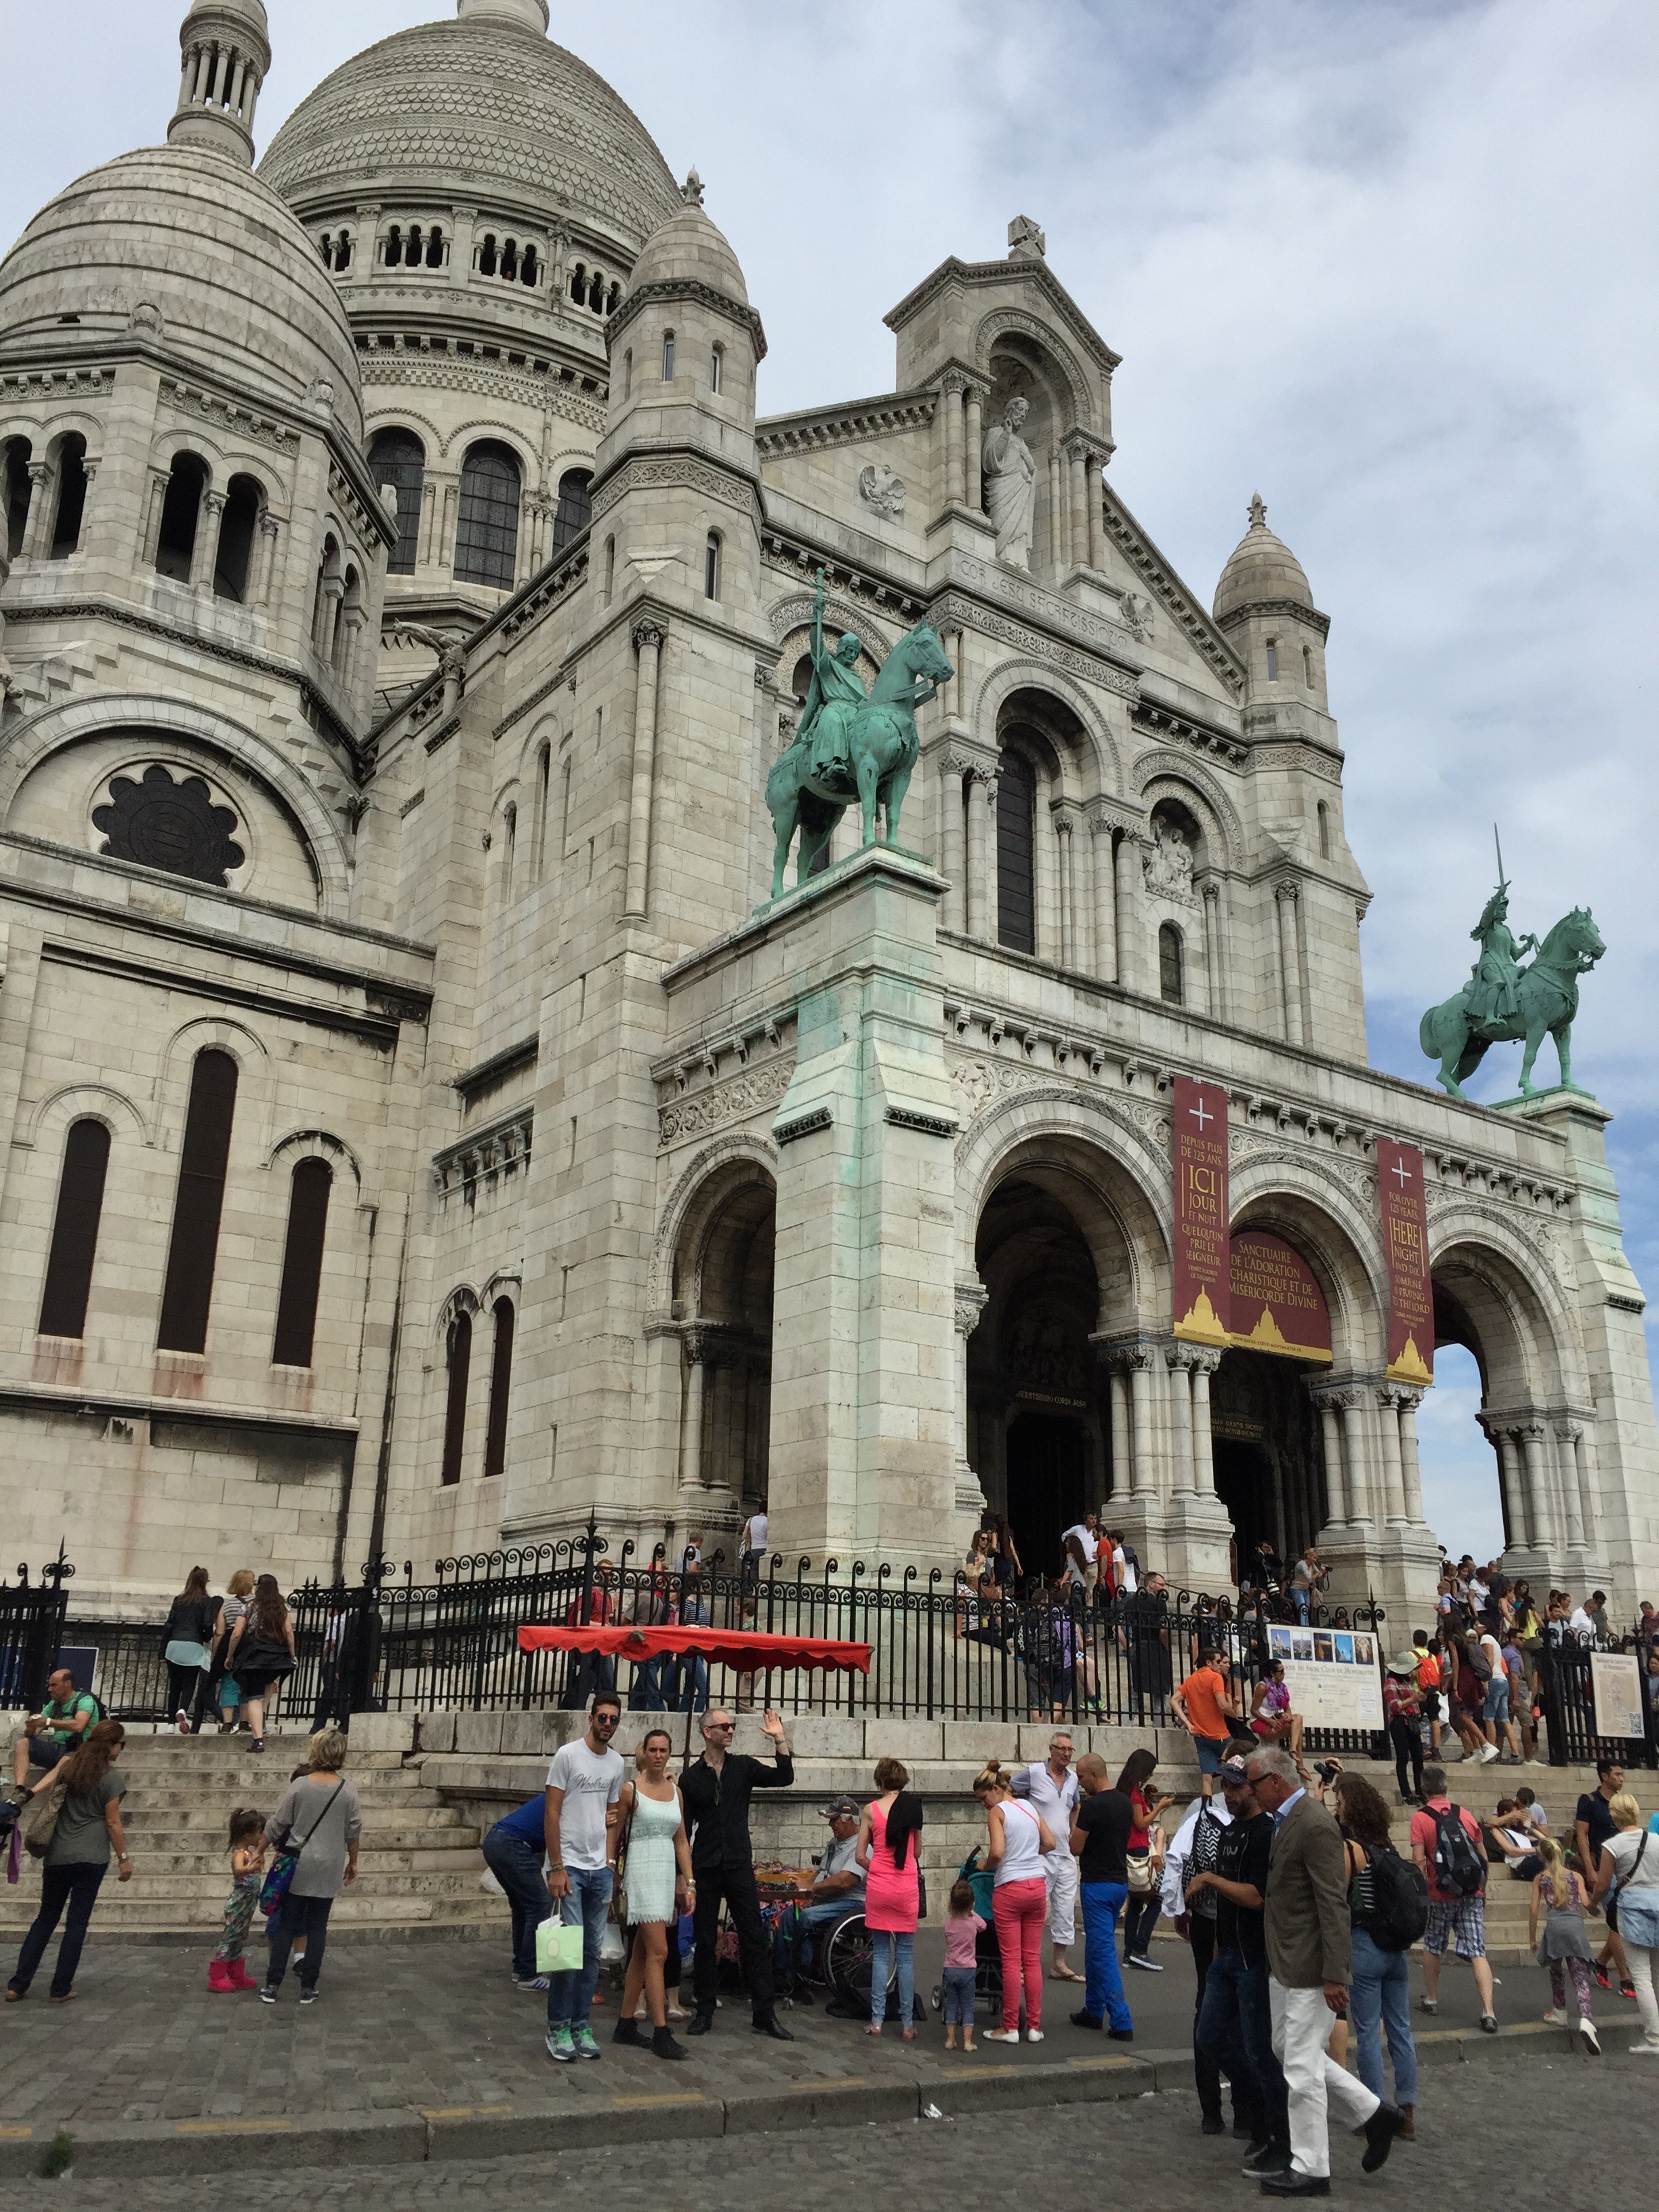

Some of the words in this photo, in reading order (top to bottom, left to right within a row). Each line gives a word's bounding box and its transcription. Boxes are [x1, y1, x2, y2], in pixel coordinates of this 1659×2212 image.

[960, 560, 987, 585] COR
[992, 575, 1025, 602] JESU
[1181, 1134, 1206, 1150] DEPUIS
[1207, 1141, 1223, 1155] PLUS
[1181, 1145, 1191, 1158] DE
[1193, 1149, 1205, 1162] 125
[1189, 1164, 1216, 1195] ICI
[1189, 1192, 1218, 1213] JOUR
[1389, 1191, 1401, 1204] FOR
[1401, 1195, 1418, 1210] OVER
[1389, 1202, 1400, 1214] 125
[1189, 1210, 1196, 1221] ET
[1181, 1223, 1224, 1242] QUELQU'UN
[1392, 1217, 1419, 1248] HERE
[1190, 1238, 1206, 1251] PRIE
[1207, 1243, 1216, 1253] LE
[1239, 1240, 1291, 1264] SANCTUAIRE
[1394, 1245, 1419, 1265] NIGHT
[1185, 1249, 1221, 1267] SEIGNEUR
[1231, 1254, 1242, 1267] DE
[1244, 1256, 1301, 1279] L'ADORATION
[1395, 1261, 1408, 1273] AND
[1229, 1268, 1288, 1292] CHARISTIQUE
[1290, 1279, 1300, 1292] ET
[1302, 1284, 1313, 1295] DE
[1287, 1292, 1318, 1311] DIVINE
